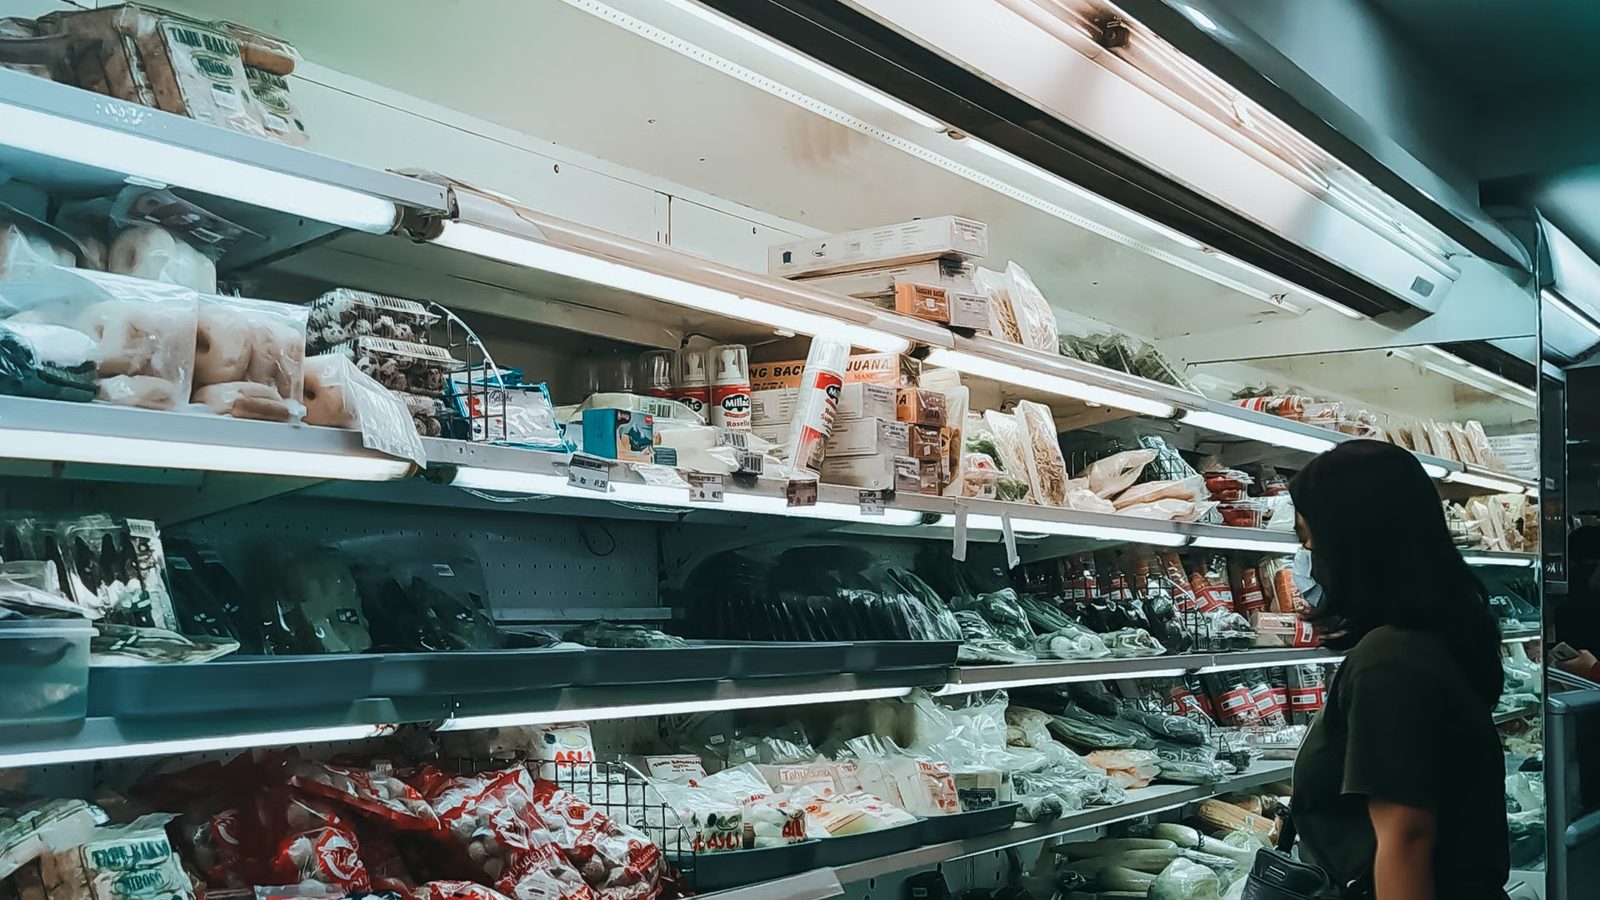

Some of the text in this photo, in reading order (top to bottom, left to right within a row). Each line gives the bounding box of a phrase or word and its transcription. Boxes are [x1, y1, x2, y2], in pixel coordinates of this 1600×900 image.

[168, 27, 240, 58] TAHU BAKSO
[724, 397, 750, 409] Millac
[706, 831, 740, 850] ASLI
